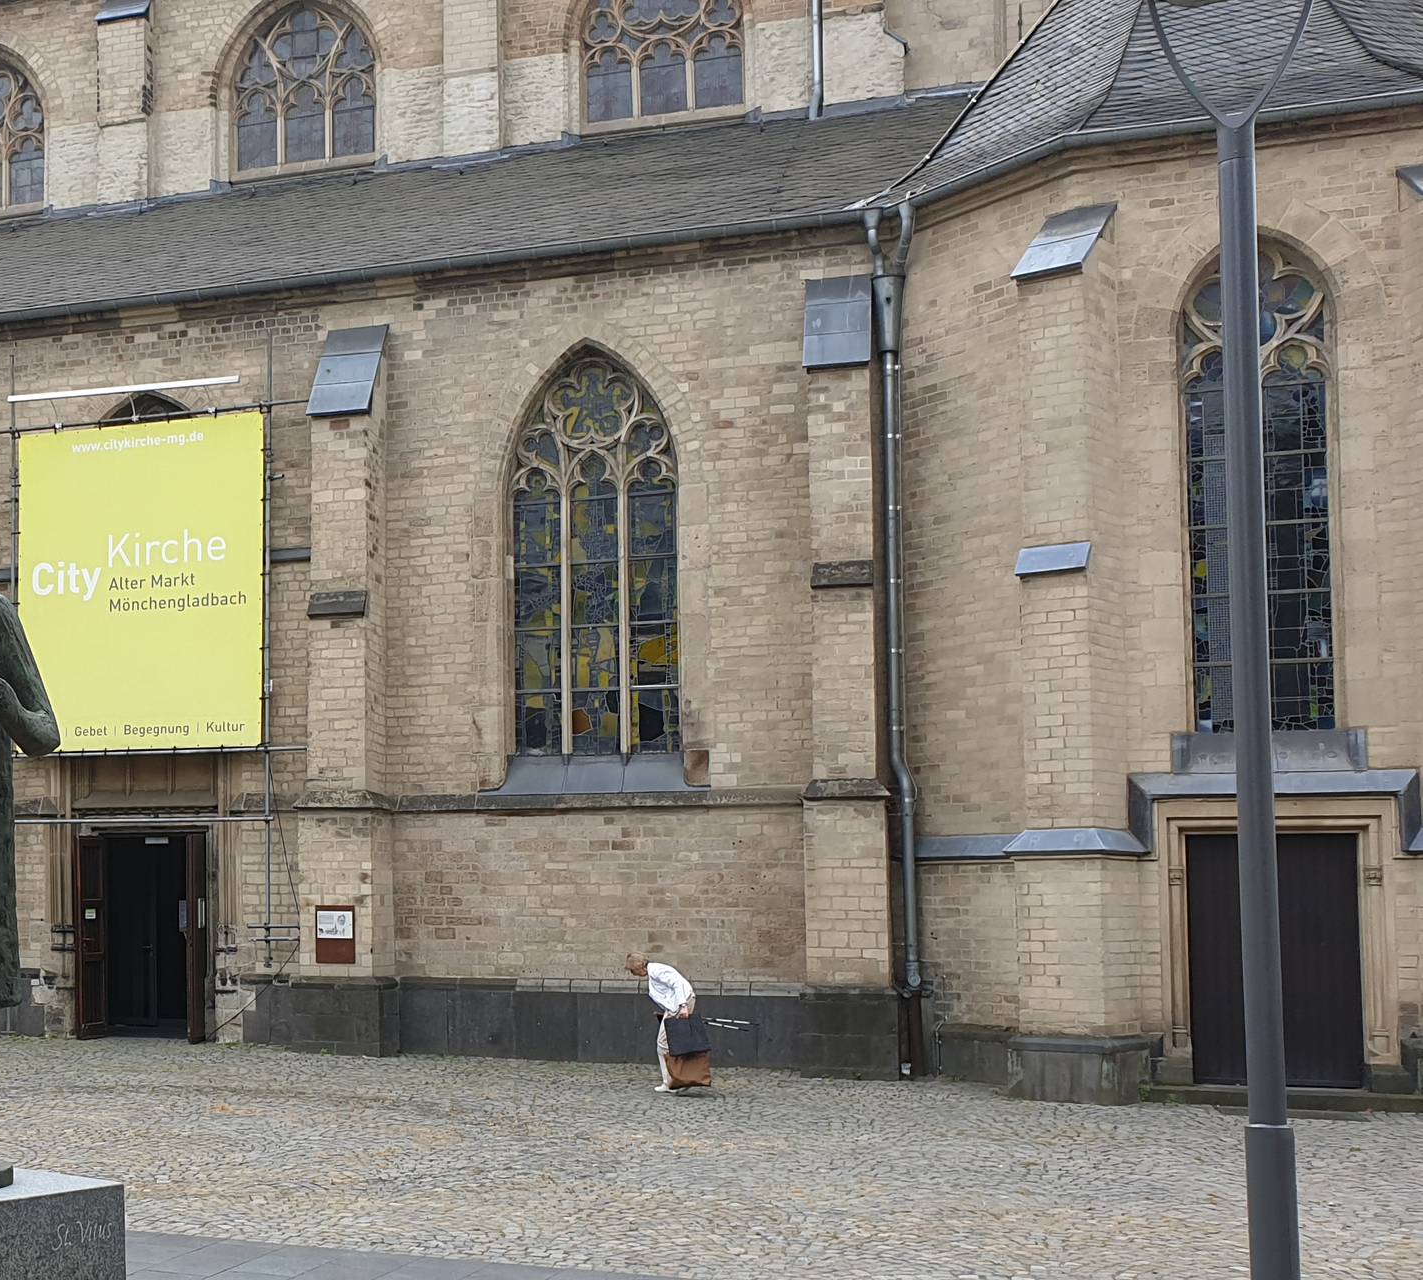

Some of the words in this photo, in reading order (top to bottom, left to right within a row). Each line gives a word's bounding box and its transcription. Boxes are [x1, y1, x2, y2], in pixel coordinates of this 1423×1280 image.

[71, 431, 204, 453] www.citykirche-mg.de
[32, 560, 102, 601] City
[107, 528, 227, 568] Kirche
[108, 575, 146, 591] Alter
[150, 572, 196, 588] Markt
[109, 591, 247, 612] Mönchengladbach
[74, 725, 108, 737] Gebet
[123, 723, 190, 738] Begegnung
[206, 721, 245, 733] Kultur
